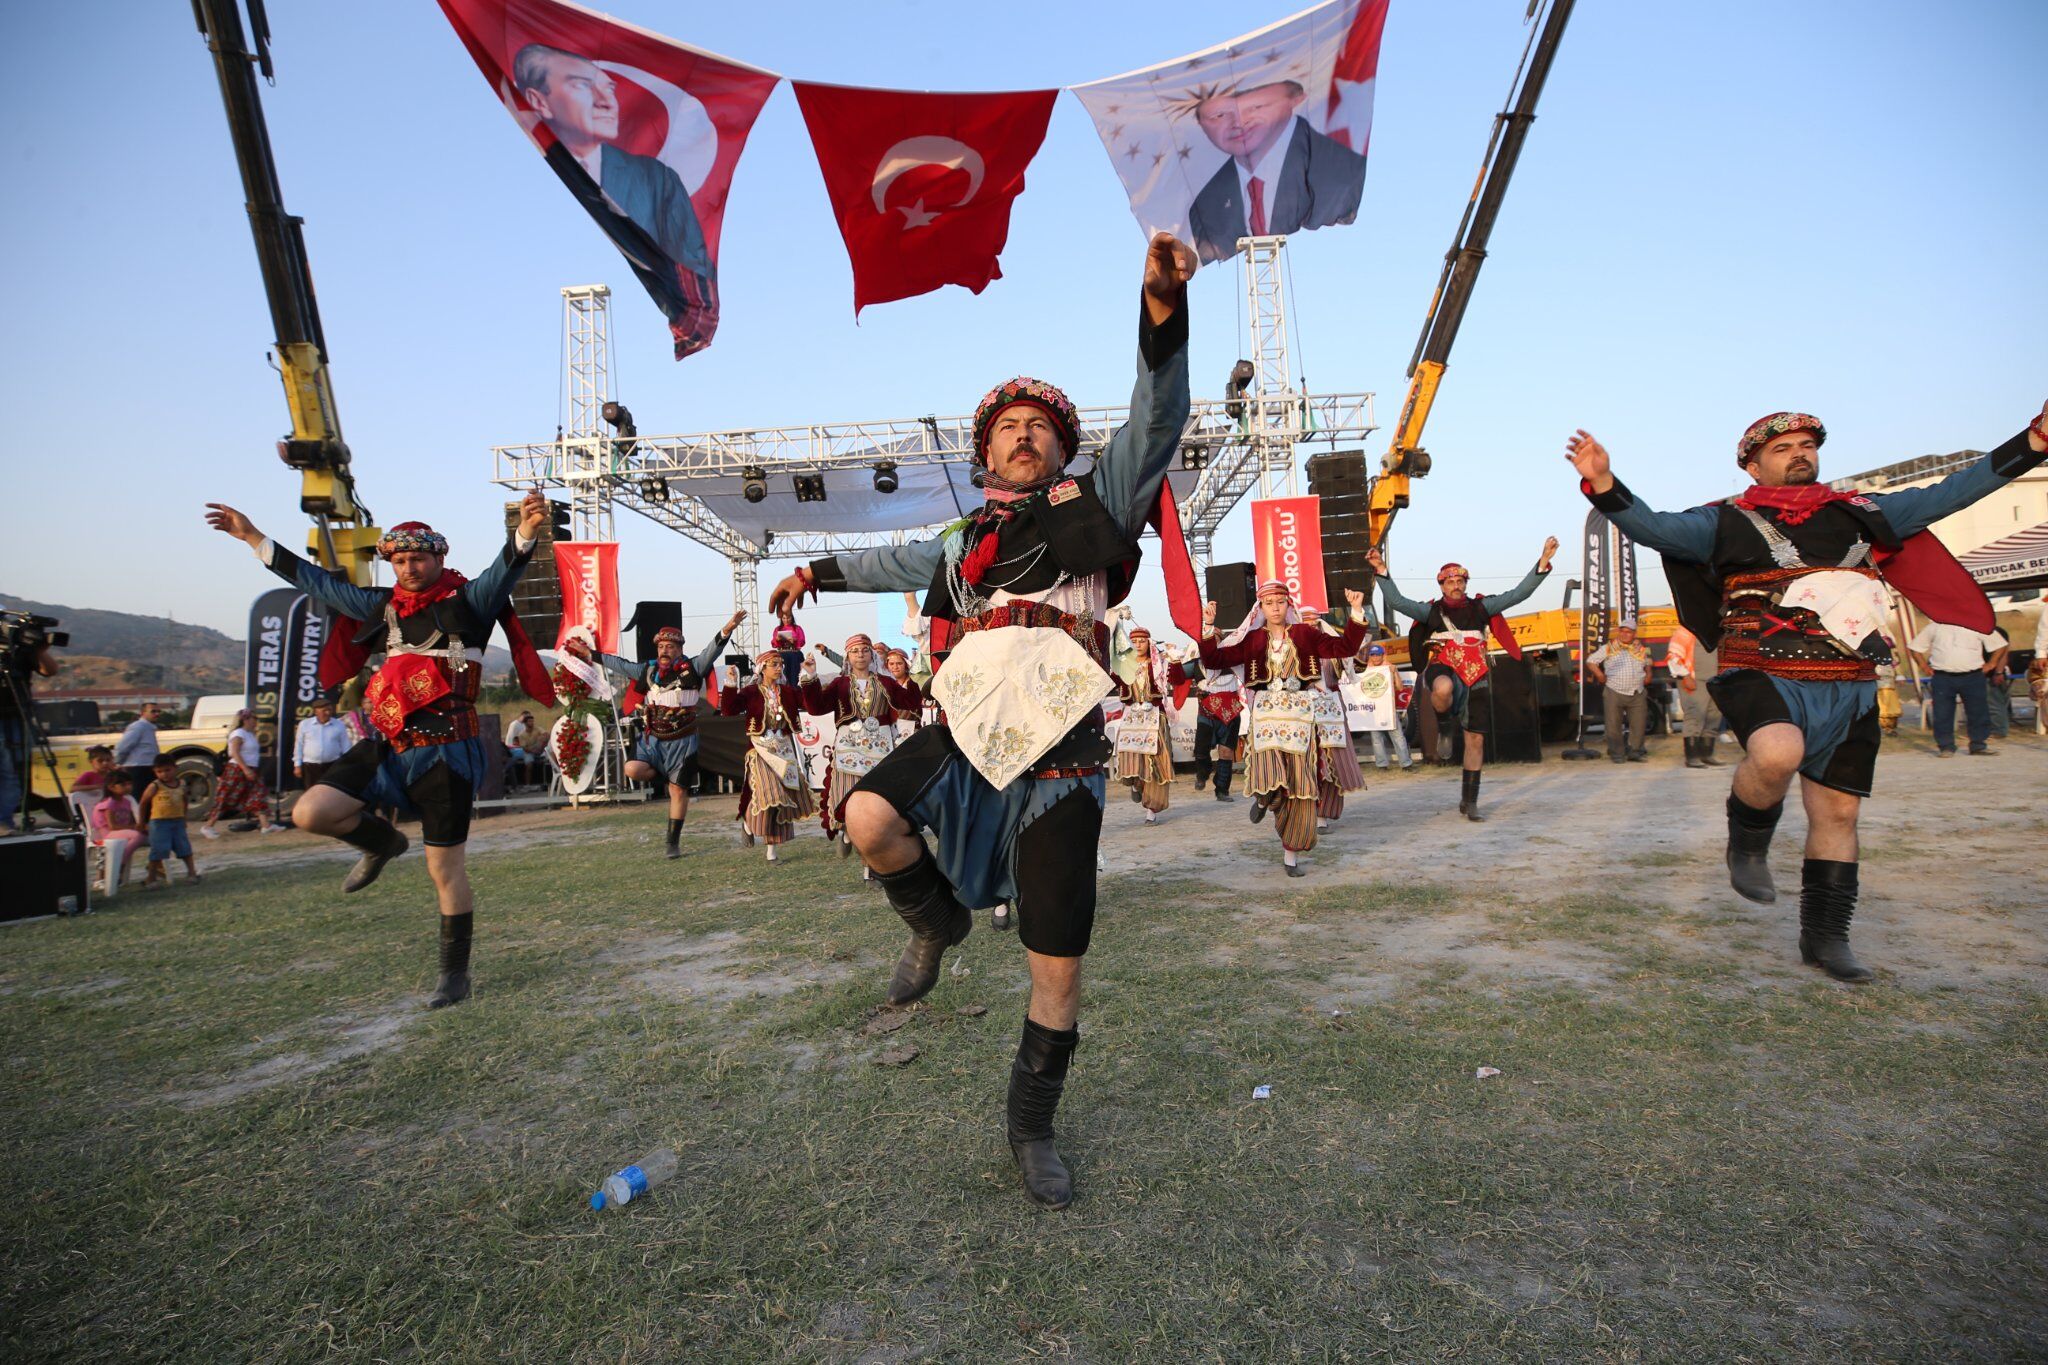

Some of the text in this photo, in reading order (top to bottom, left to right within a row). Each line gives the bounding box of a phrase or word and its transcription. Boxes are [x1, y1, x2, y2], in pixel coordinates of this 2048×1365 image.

[580, 555, 597, 633] OROĞLU
[1589, 532, 1600, 607] TERAS
[2030, 558, 2048, 568] BE
[257, 615, 282, 686] TERAS
[298, 611, 323, 702] COUNTRY
